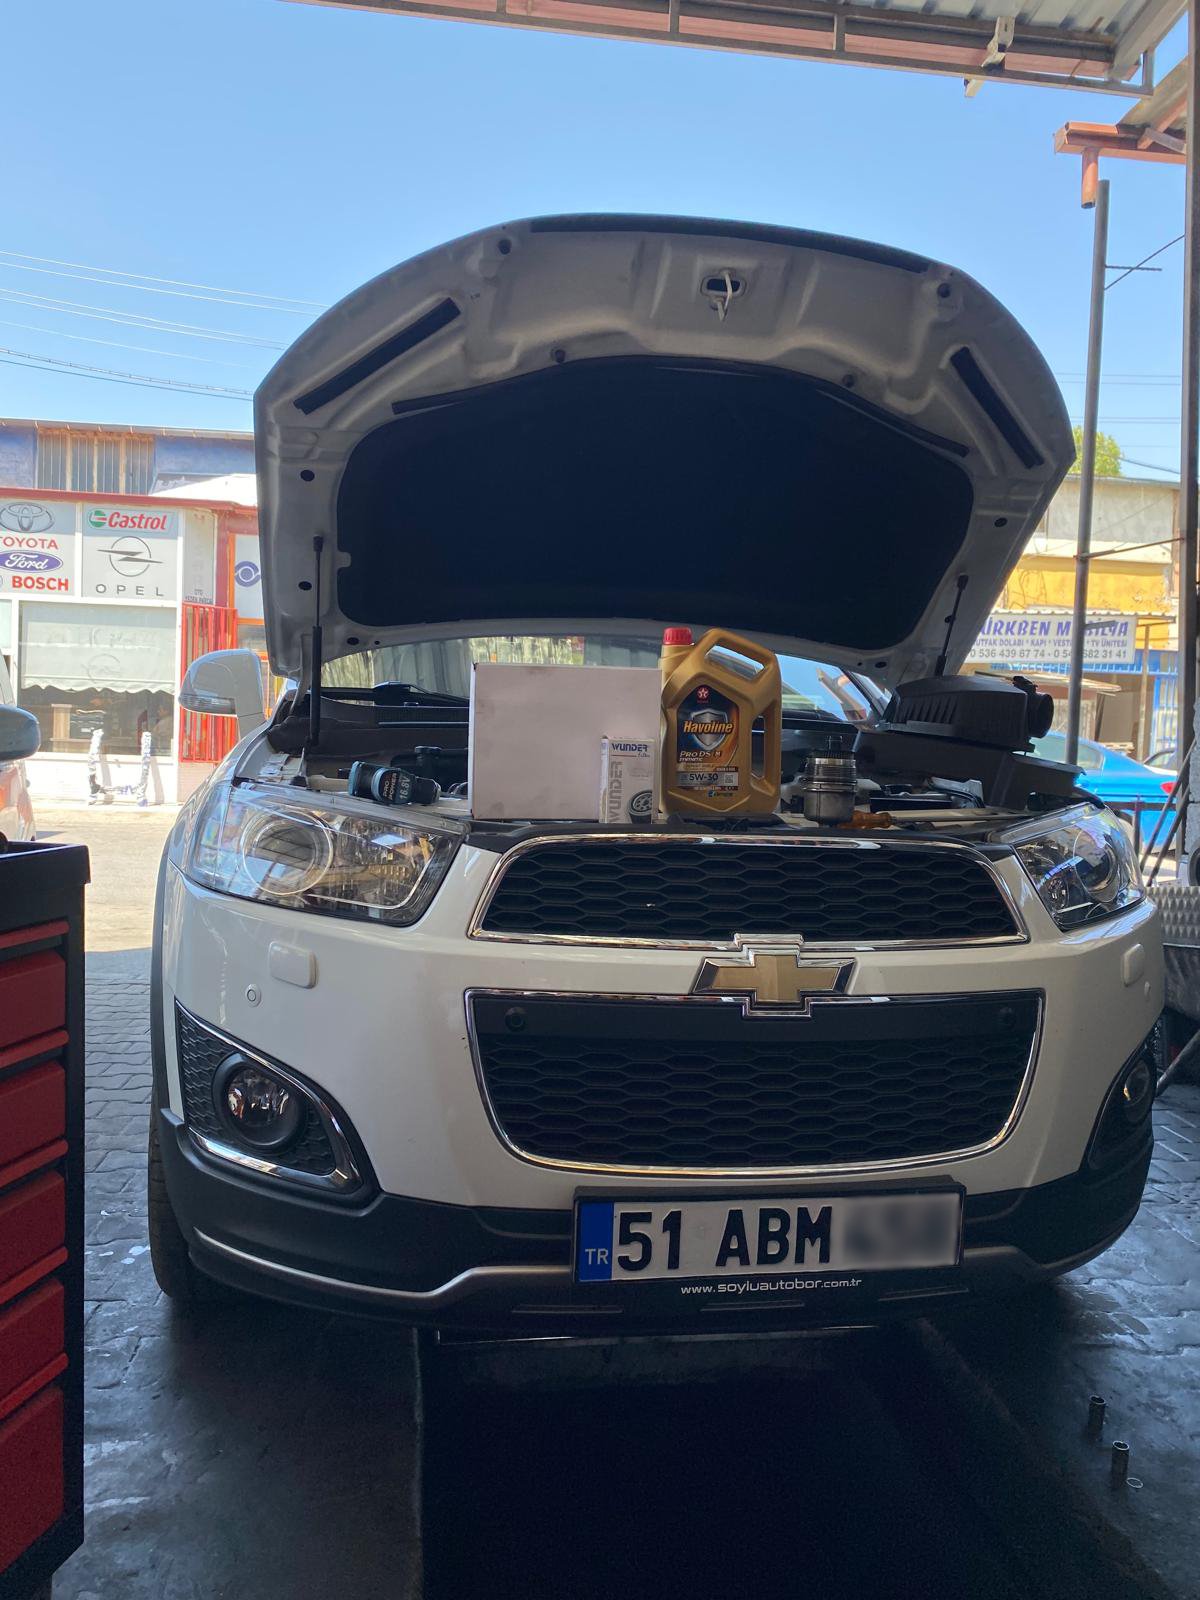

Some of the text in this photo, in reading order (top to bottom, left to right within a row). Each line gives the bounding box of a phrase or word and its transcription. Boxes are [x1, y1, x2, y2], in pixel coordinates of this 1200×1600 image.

[108, 511, 167, 530] Castrol
[5, 553, 49, 570] Ford
[12, 575, 69, 591] BOSCH
[95, 583, 164, 597] OPEL
[1031, 639, 1046, 648] KAPI
[970, 649, 976, 658] 0
[979, 648, 997, 658] 536
[998, 648, 1017, 658] 439
[1033, 648, 1046, 658] 74
[1053, 649, 1060, 658] 0
[683, 720, 733, 733] Havoline
[611, 743, 648, 752] WUNDER
[689, 773, 719, 781] 5W-30
[609, 761, 622, 823] WUNDER
[617, 1210, 682, 1271] 51
[715, 1206, 833, 1267] ABM
[584, 1248, 609, 1265] TR
